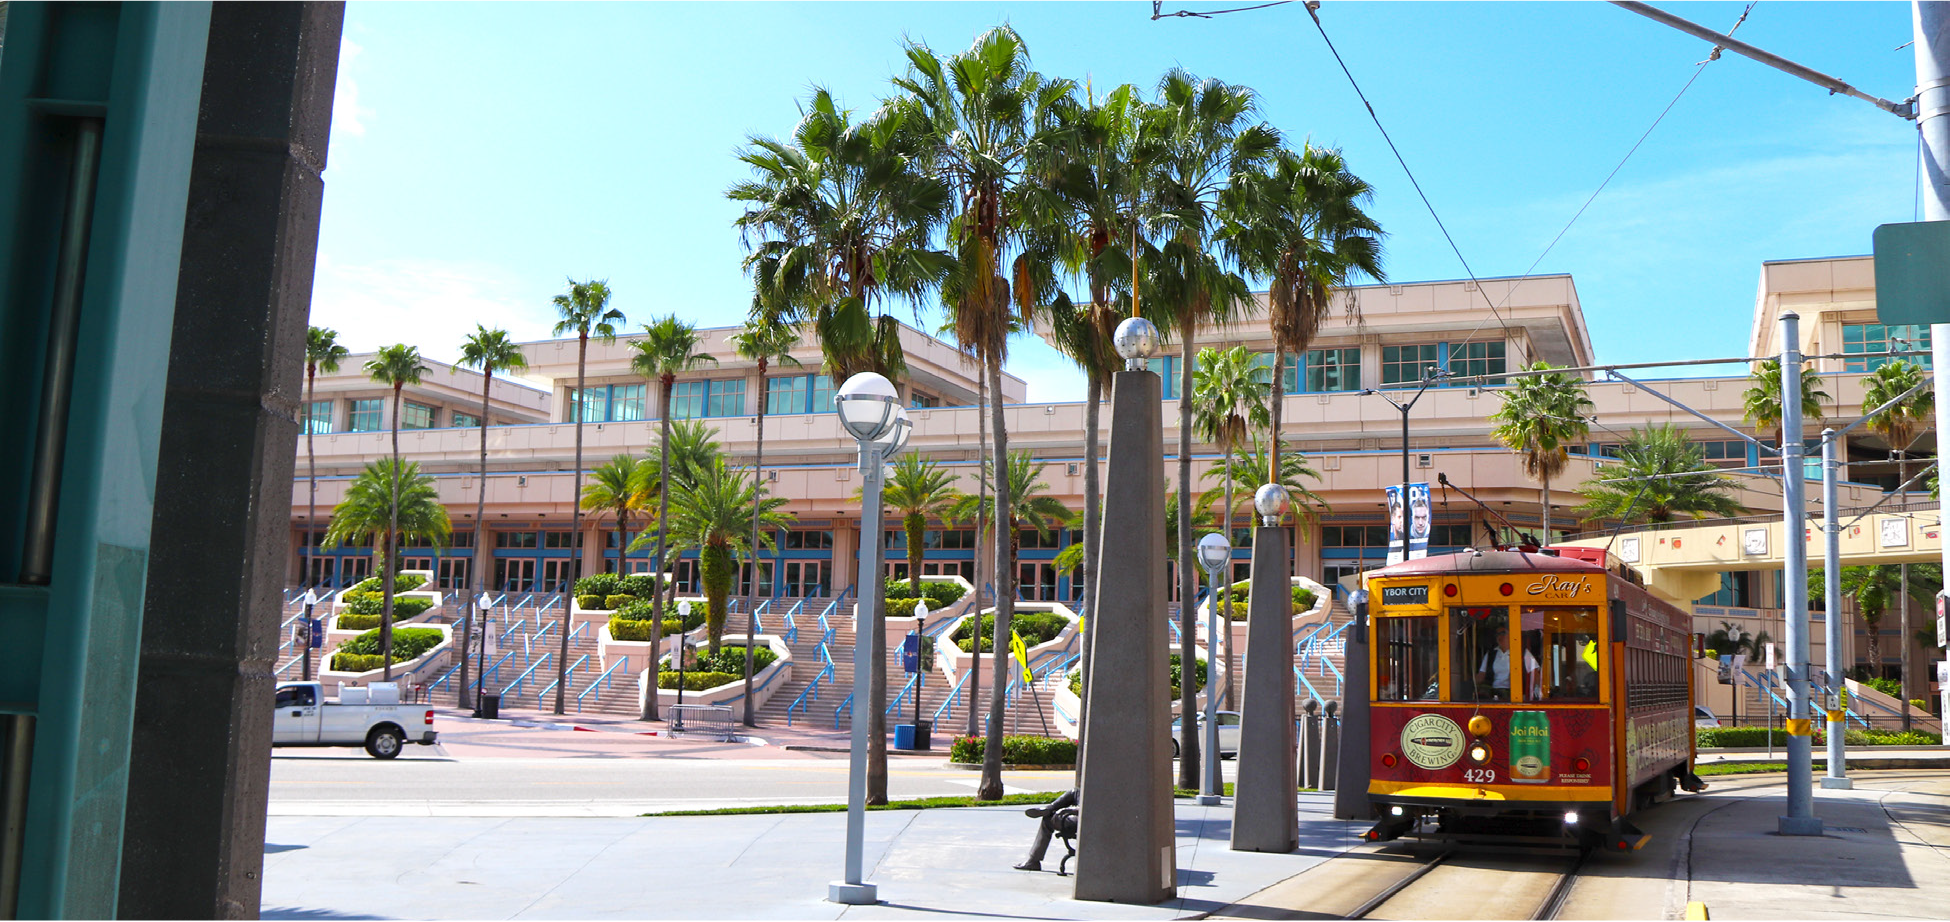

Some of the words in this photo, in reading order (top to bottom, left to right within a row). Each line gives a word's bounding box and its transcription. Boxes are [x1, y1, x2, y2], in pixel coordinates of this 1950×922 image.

[1384, 588, 1407, 596] YBOR
[1408, 587, 1428, 596] CITY
[1526, 574, 1591, 598] Ray's
[1409, 718, 1435, 733] CIGAR
[1435, 719, 1456, 734] CITY
[1510, 726, 1527, 736] Jai
[1528, 726, 1548, 736] Alai
[1409, 749, 1455, 765] BREWING
[1464, 769, 1496, 783] 429
